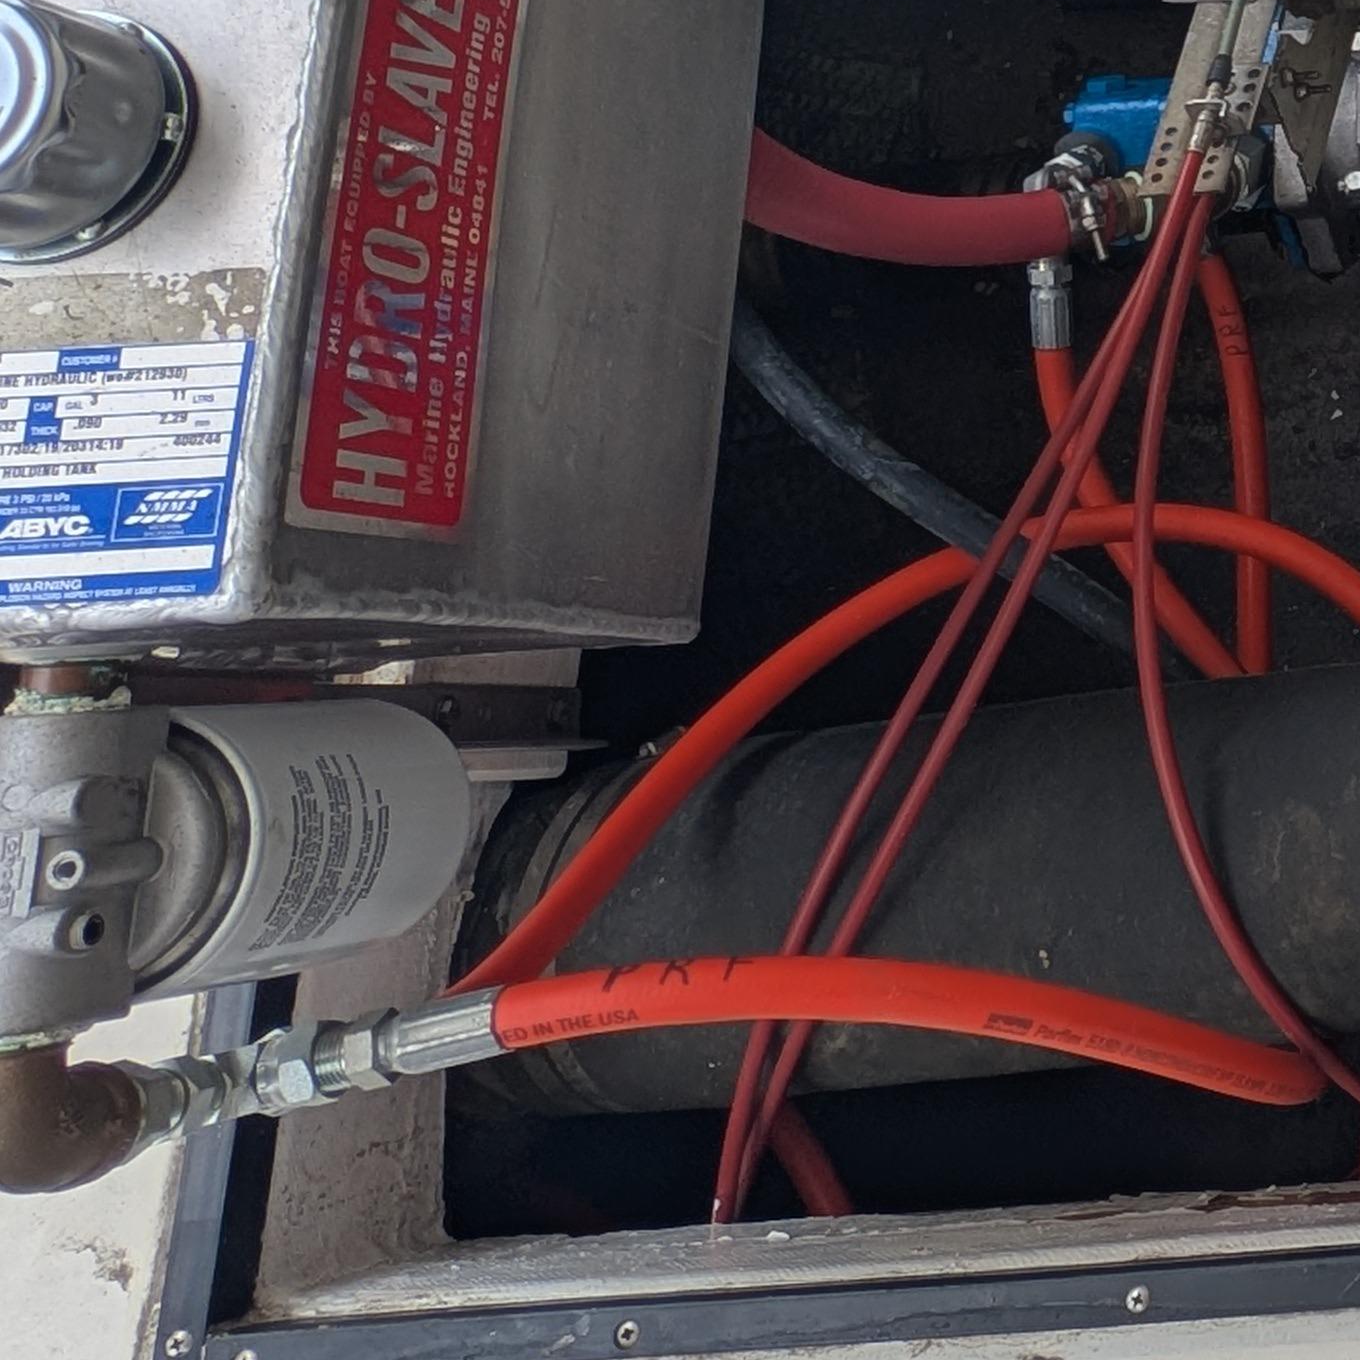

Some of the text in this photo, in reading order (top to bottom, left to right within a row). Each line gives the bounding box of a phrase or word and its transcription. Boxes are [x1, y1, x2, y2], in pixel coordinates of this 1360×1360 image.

[448, 15, 489, 196] Engineering
[327, 72, 378, 368] THIS BOAT EQUIPPED BY
[427, 206, 464, 362] Hydraulic
[444, 346, 470, 497] ROCKLAND,
[470, 165, 488, 246] 04841
[484, 73, 501, 121] TEL.
[24, 371, 97, 386] HYDRAULIC
[2, 464, 96, 479] HOLDING TANK
[414, 378, 444, 495] Marine
[0, 515, 90, 539] ABYC
[8, 579, 82, 593] WARNING
[533, 1023, 553, 1038] IN
[556, 1014, 592, 1034] THE
[599, 1008, 640, 1028] USA
